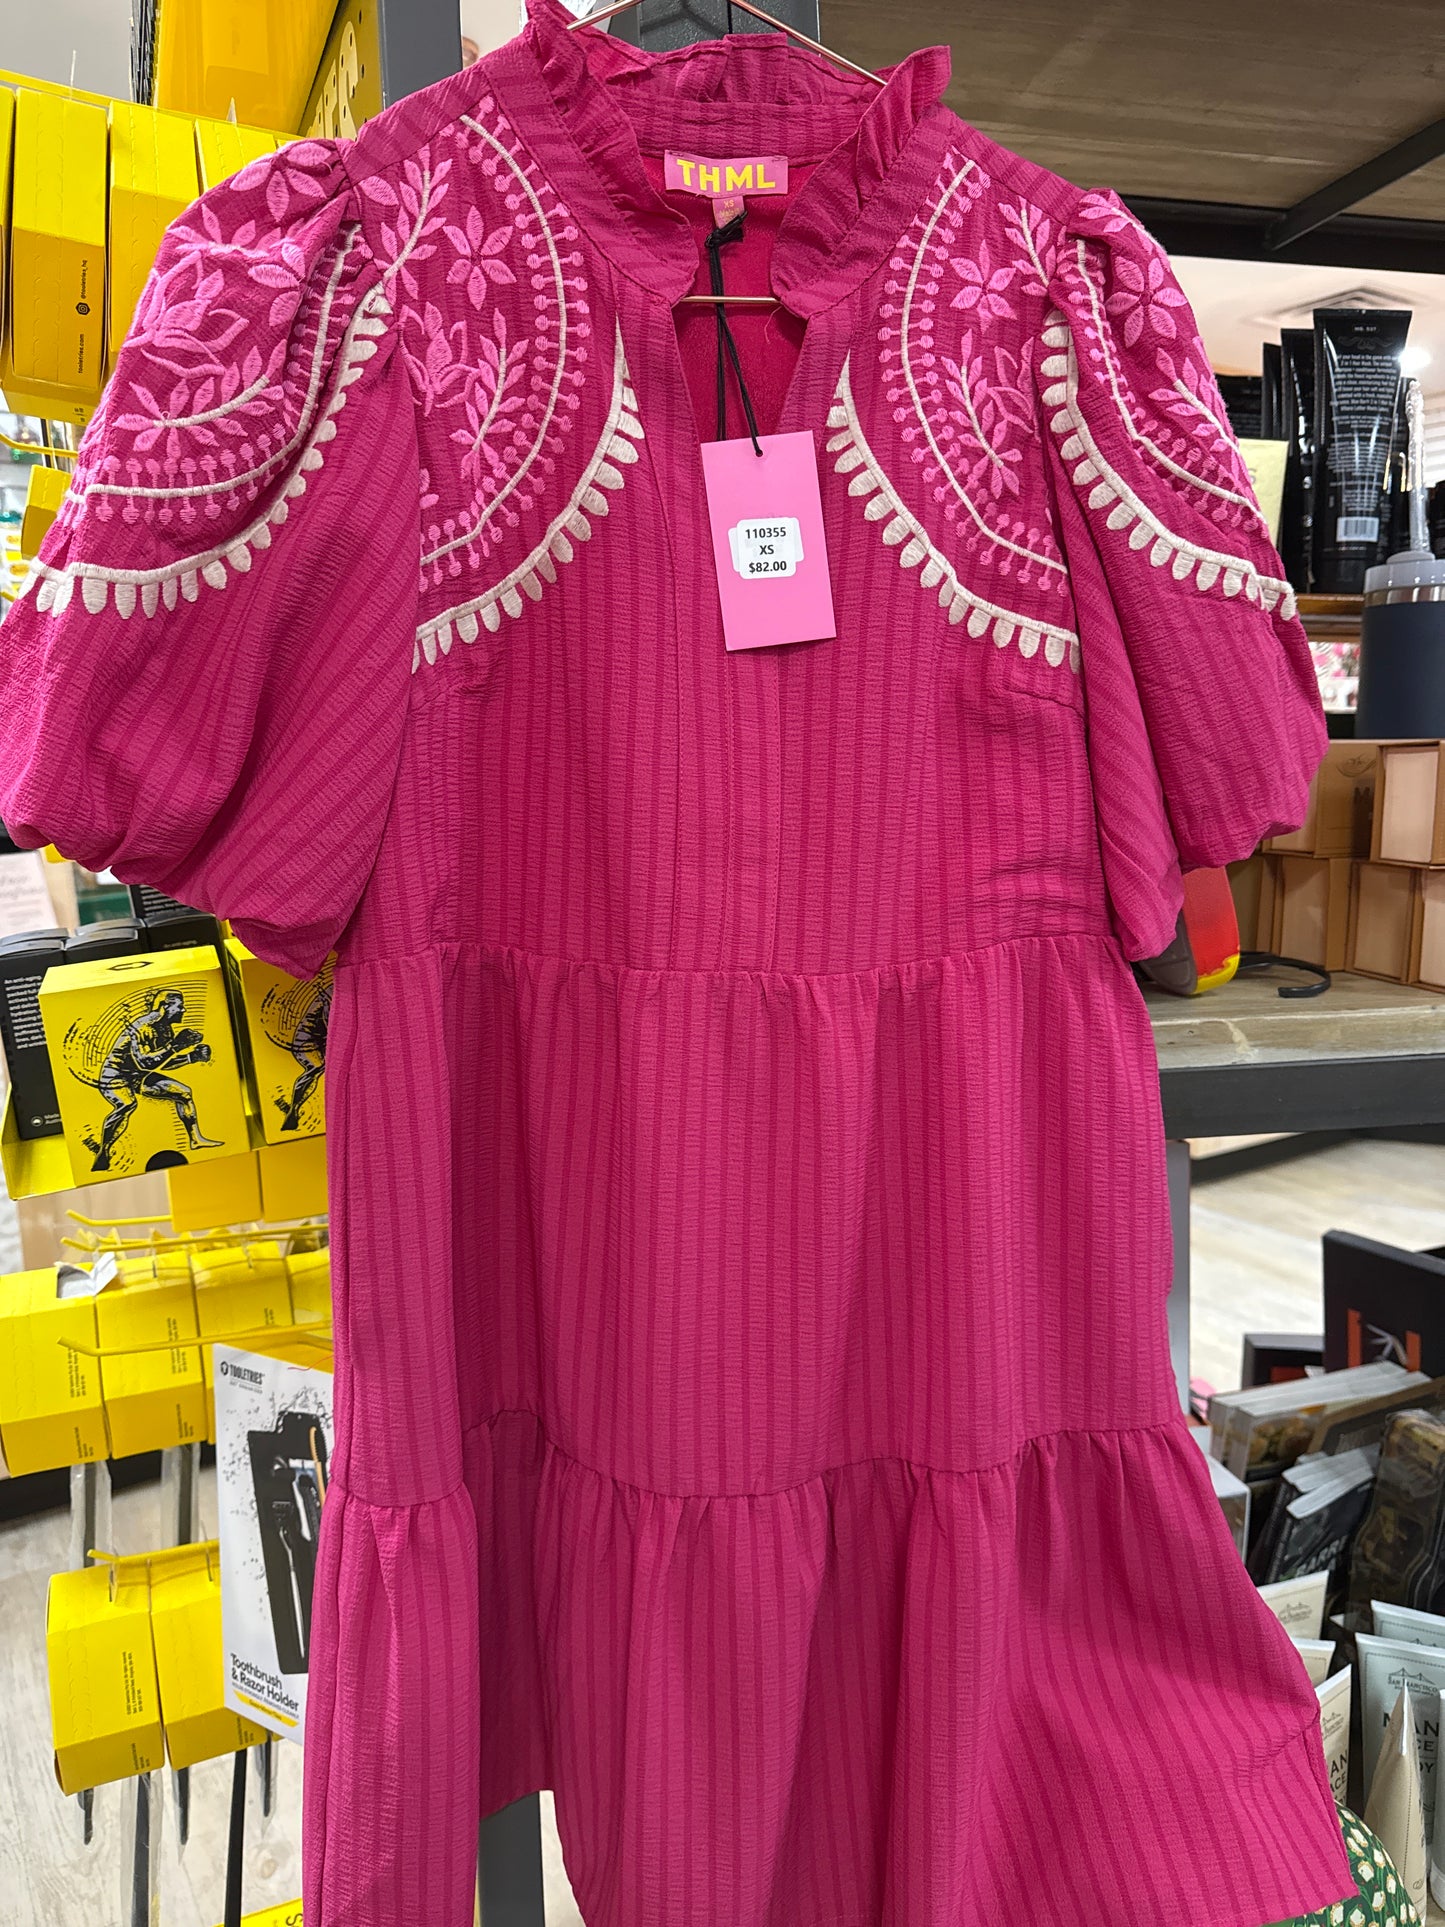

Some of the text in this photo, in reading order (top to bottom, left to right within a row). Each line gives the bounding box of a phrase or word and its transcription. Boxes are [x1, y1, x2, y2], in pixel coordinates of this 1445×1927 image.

[677, 159, 776, 192] THML
[745, 527, 787, 539] 110355
[759, 545, 774, 555] XS
[749, 561, 787, 574] $82.00
[230, 1653, 282, 1690] Toothbrush
[231, 1667, 239, 1681] &
[240, 1671, 265, 1695] Razor
[267, 1685, 299, 1712] Holder
